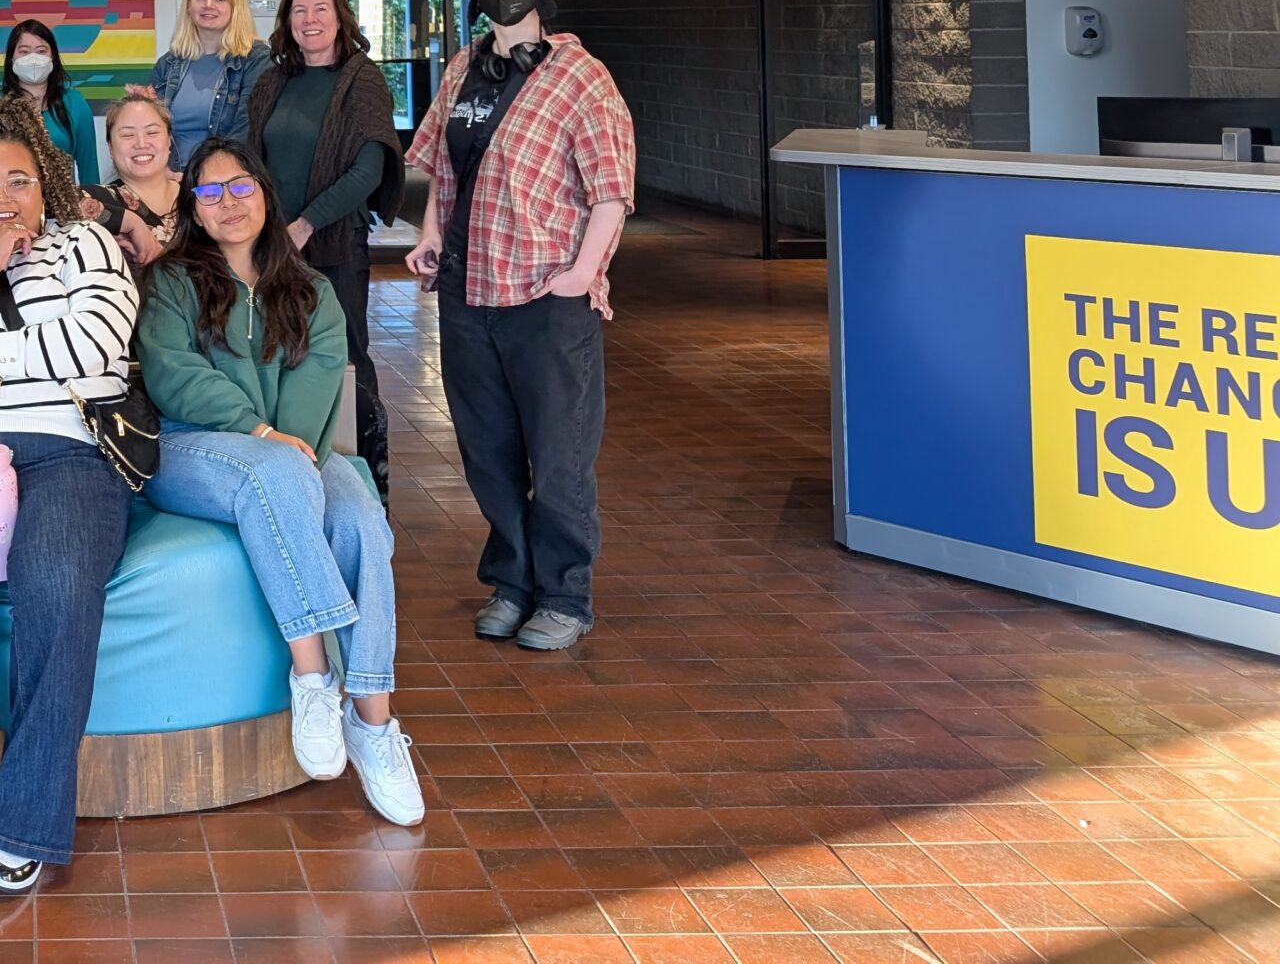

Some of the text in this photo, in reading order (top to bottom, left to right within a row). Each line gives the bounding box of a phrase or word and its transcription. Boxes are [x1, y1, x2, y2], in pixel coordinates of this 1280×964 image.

[1065, 293, 1180, 348] THE
[1068, 349, 1280, 422] CHAN
[1075, 409, 1177, 509] IS
